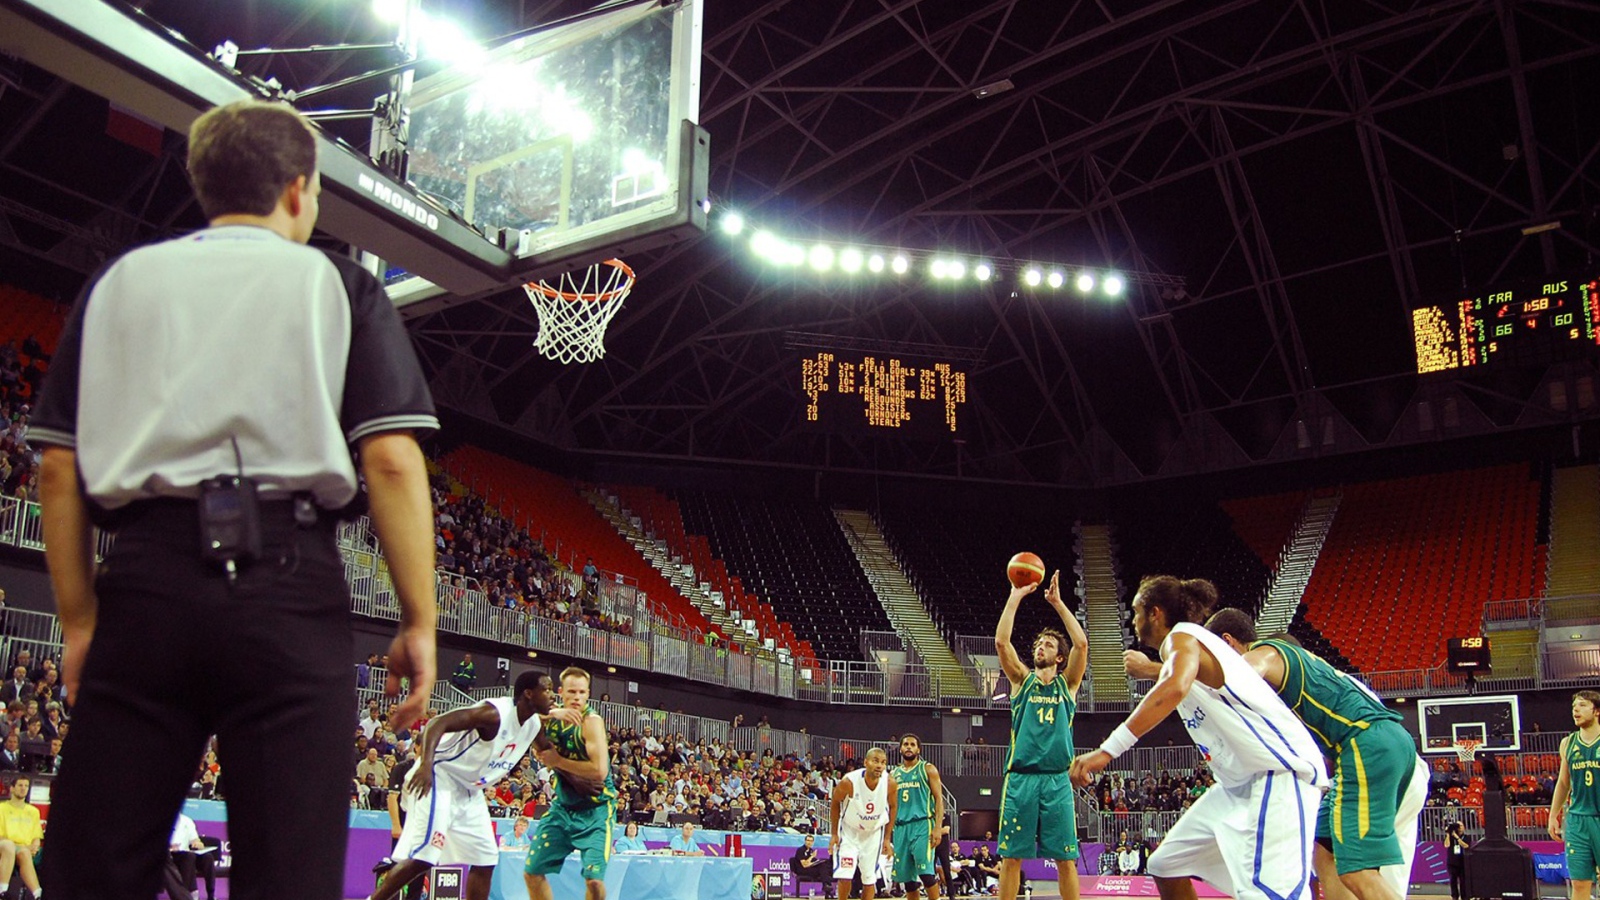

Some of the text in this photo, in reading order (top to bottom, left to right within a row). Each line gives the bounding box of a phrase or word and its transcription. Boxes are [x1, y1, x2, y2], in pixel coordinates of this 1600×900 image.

[374, 181, 438, 230] MONDO
[1542, 280, 1568, 295] AUS
[1488, 291, 1512, 305] FRA
[1524, 298, 1549, 312] 1:58
[1555, 312, 1573, 326] 60
[1496, 323, 1513, 336] 66
[818, 352, 834, 362] FRA
[864, 357, 874, 366] 66
[890, 358, 900, 368] 60
[802, 358, 829, 369] 23/53
[860, 363, 884, 373] FIELD
[890, 366, 916, 376] GOALS
[940, 372, 966, 380] 22/56
[934, 363, 950, 372] AUS
[802, 367, 829, 376] 22/43
[874, 372, 906, 383] POINTS
[940, 380, 966, 388] 14/30
[803, 374, 824, 384] 1/10
[874, 380, 906, 390] POINTS
[802, 382, 829, 391] 19/30
[860, 386, 880, 396] FREE
[885, 388, 916, 398] THROWS
[864, 394, 906, 405] REBOUNDS
[807, 404, 818, 413] 20
[864, 408, 910, 420] TURNOVERS
[870, 402, 906, 412] ASSISTS
[808, 412, 818, 420] 10
[869, 418, 900, 428] STEALS
[1461, 637, 1483, 648] 1:58
[1036, 707, 1055, 724] 14
[1584, 770, 1594, 787] 9
[902, 790, 910, 802] 5
[866, 802, 875, 814] 9
[770, 858, 790, 870] London
[438, 873, 458, 888] FIBA
[1096, 884, 1130, 892] Prepares
